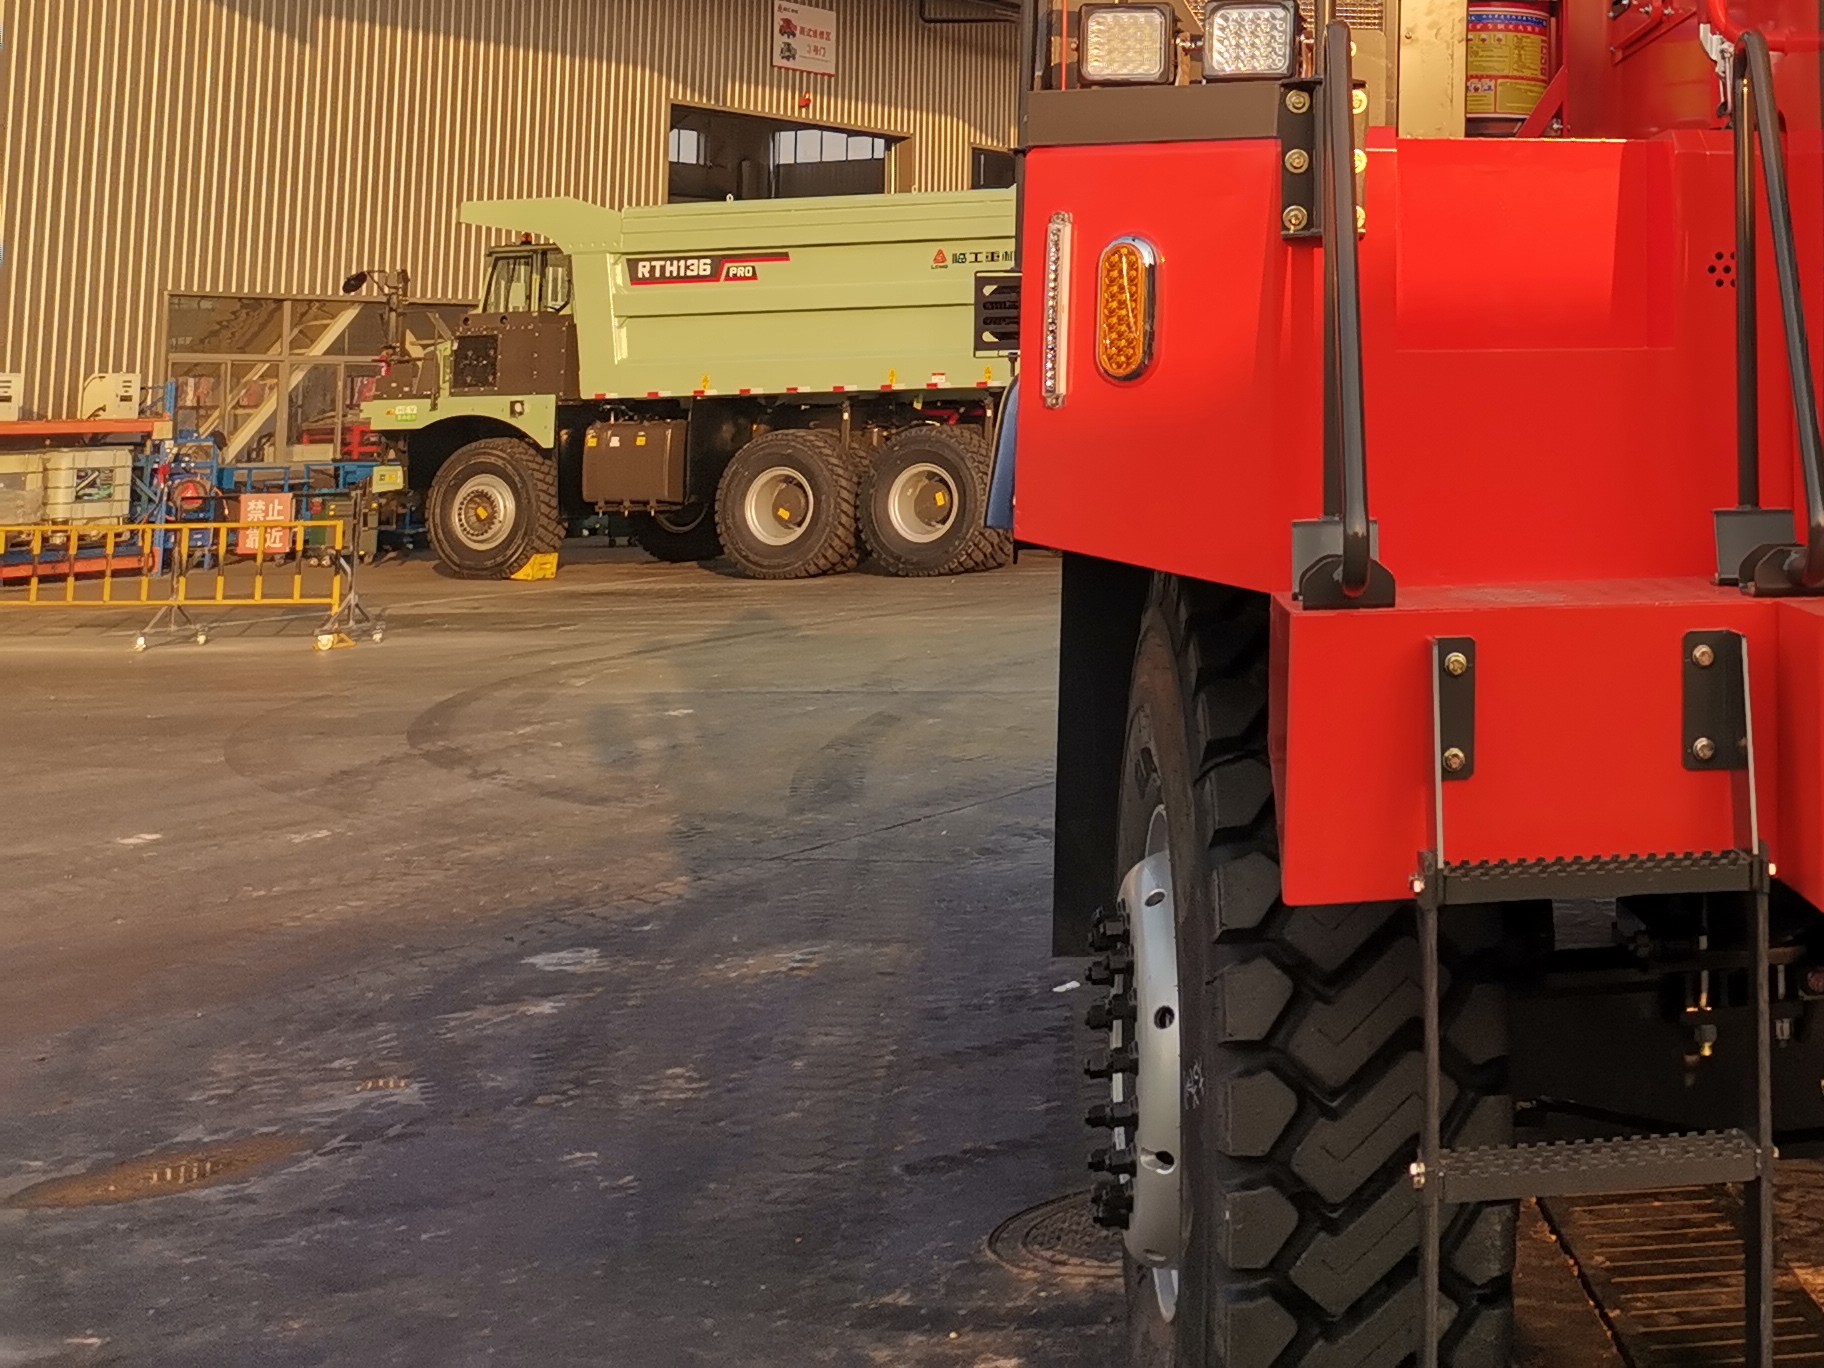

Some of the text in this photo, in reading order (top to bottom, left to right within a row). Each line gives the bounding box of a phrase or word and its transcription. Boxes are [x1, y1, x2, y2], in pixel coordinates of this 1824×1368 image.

[637, 258, 753, 278] RTH136 PRO
[247, 498, 284, 521] 禁止
